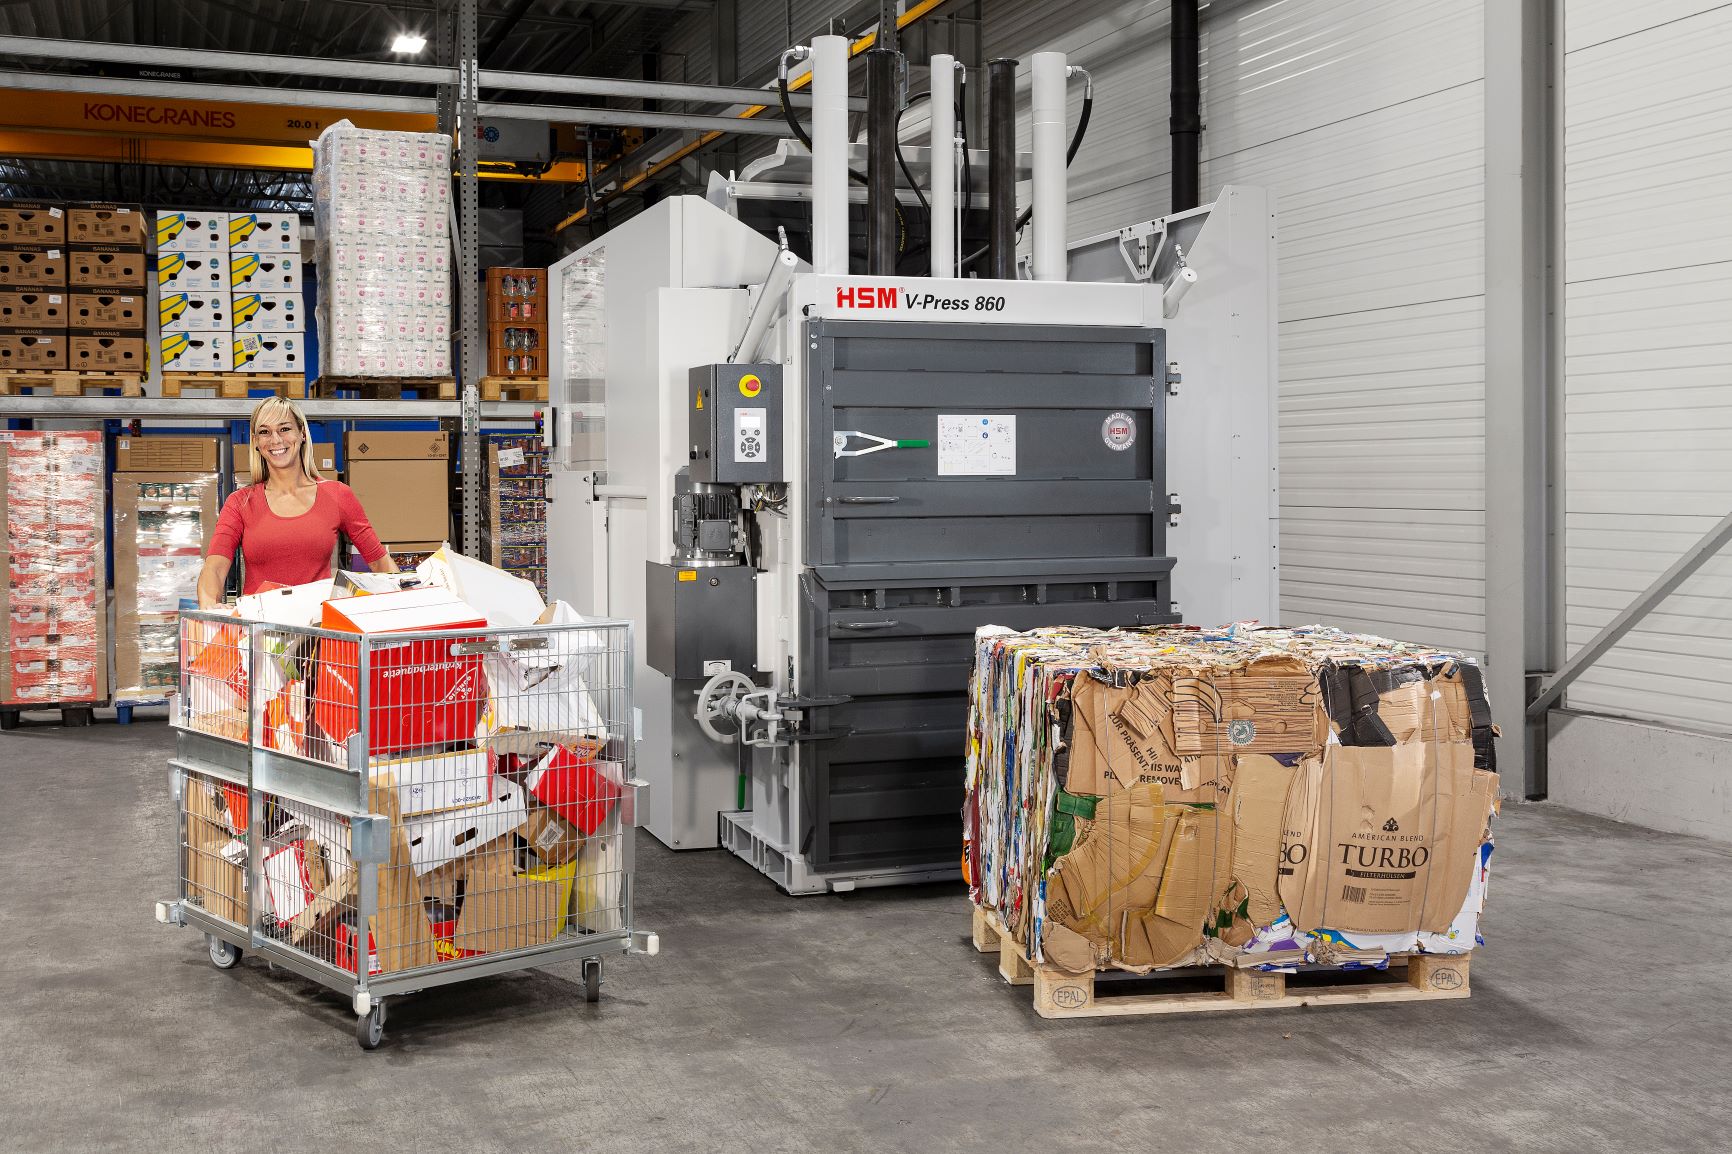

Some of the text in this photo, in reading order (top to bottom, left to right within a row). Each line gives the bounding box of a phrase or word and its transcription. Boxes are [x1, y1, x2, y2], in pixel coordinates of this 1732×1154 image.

[138, 70, 182, 79] KONECRANES
[84, 102, 237, 129] KONECRANES
[286, 118, 312, 129] 20.0
[905, 293, 970, 311] V-Press
[974, 296, 1006, 312] 860
[1105, 412, 1125, 425] MADE
[1110, 427, 1128, 435] HSM
[1104, 437, 1134, 451] GERMANY
[1108, 711, 1150, 771] ZUR PRÄSENT
[1351, 832, 1397, 842] AMERICAN
[1338, 843, 1429, 869] TURBO
[1435, 973, 1458, 986] EPAL
[1057, 991, 1083, 1004] EPAL
